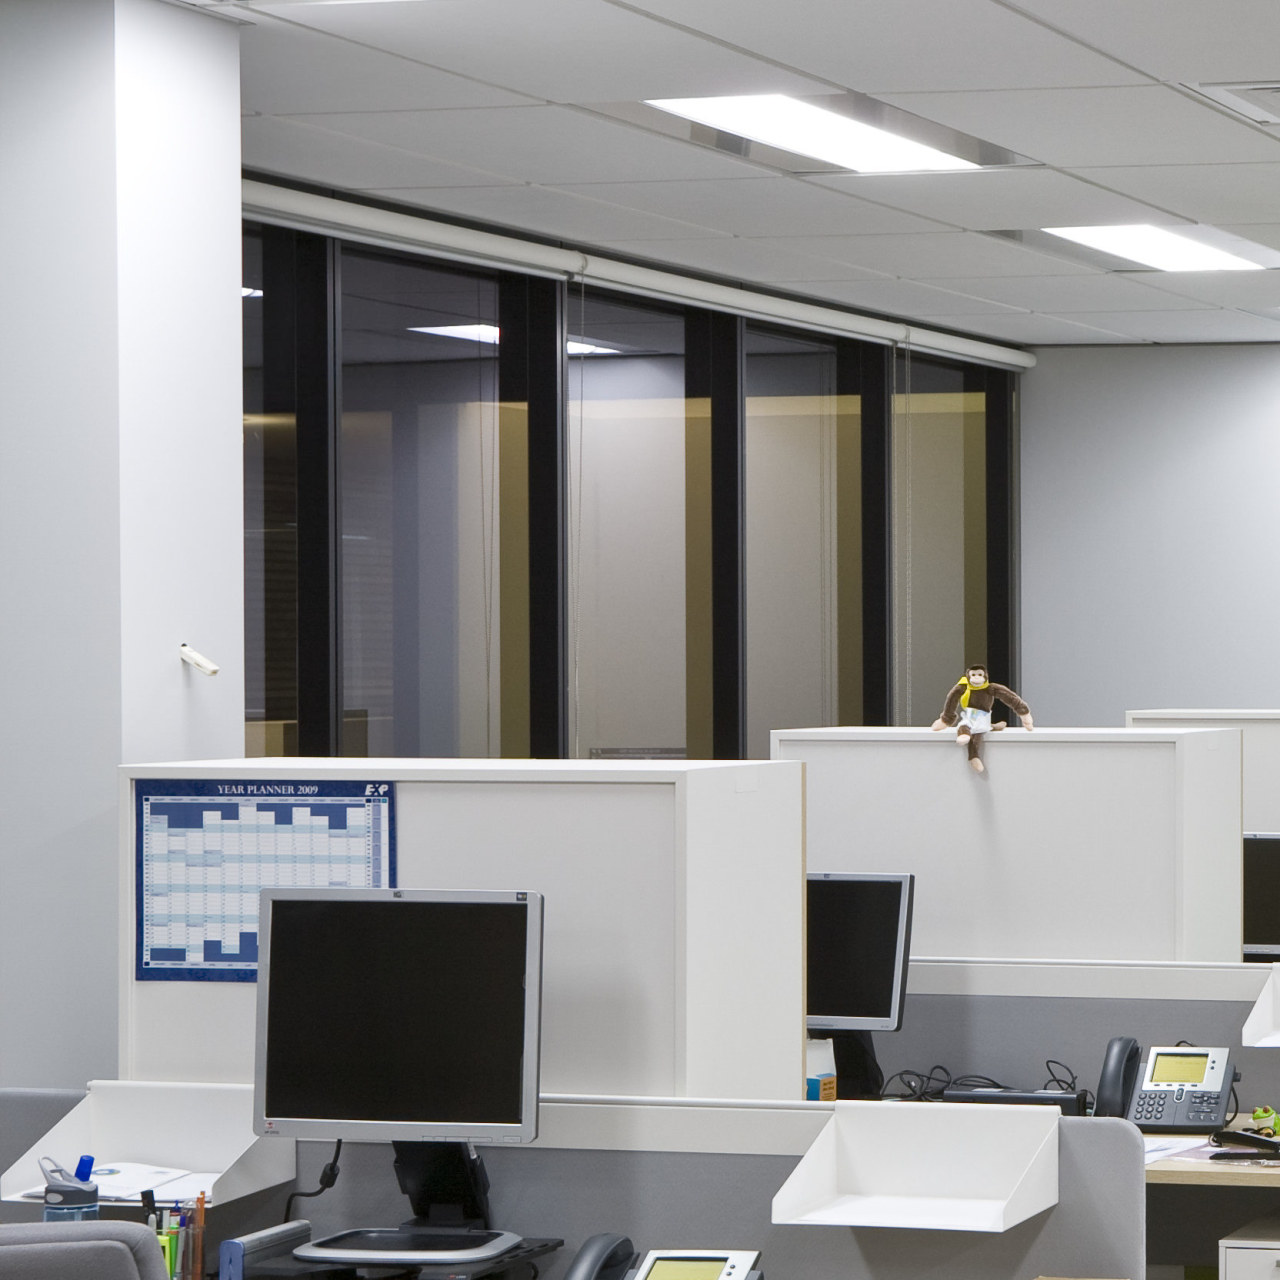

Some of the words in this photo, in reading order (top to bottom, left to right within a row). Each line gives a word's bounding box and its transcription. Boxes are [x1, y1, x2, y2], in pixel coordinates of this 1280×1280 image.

[217, 784, 245, 795] YEAR
[247, 784, 295, 795] PLANNER
[297, 784, 319, 795] 2009
[364, 783, 389, 796] EXP
